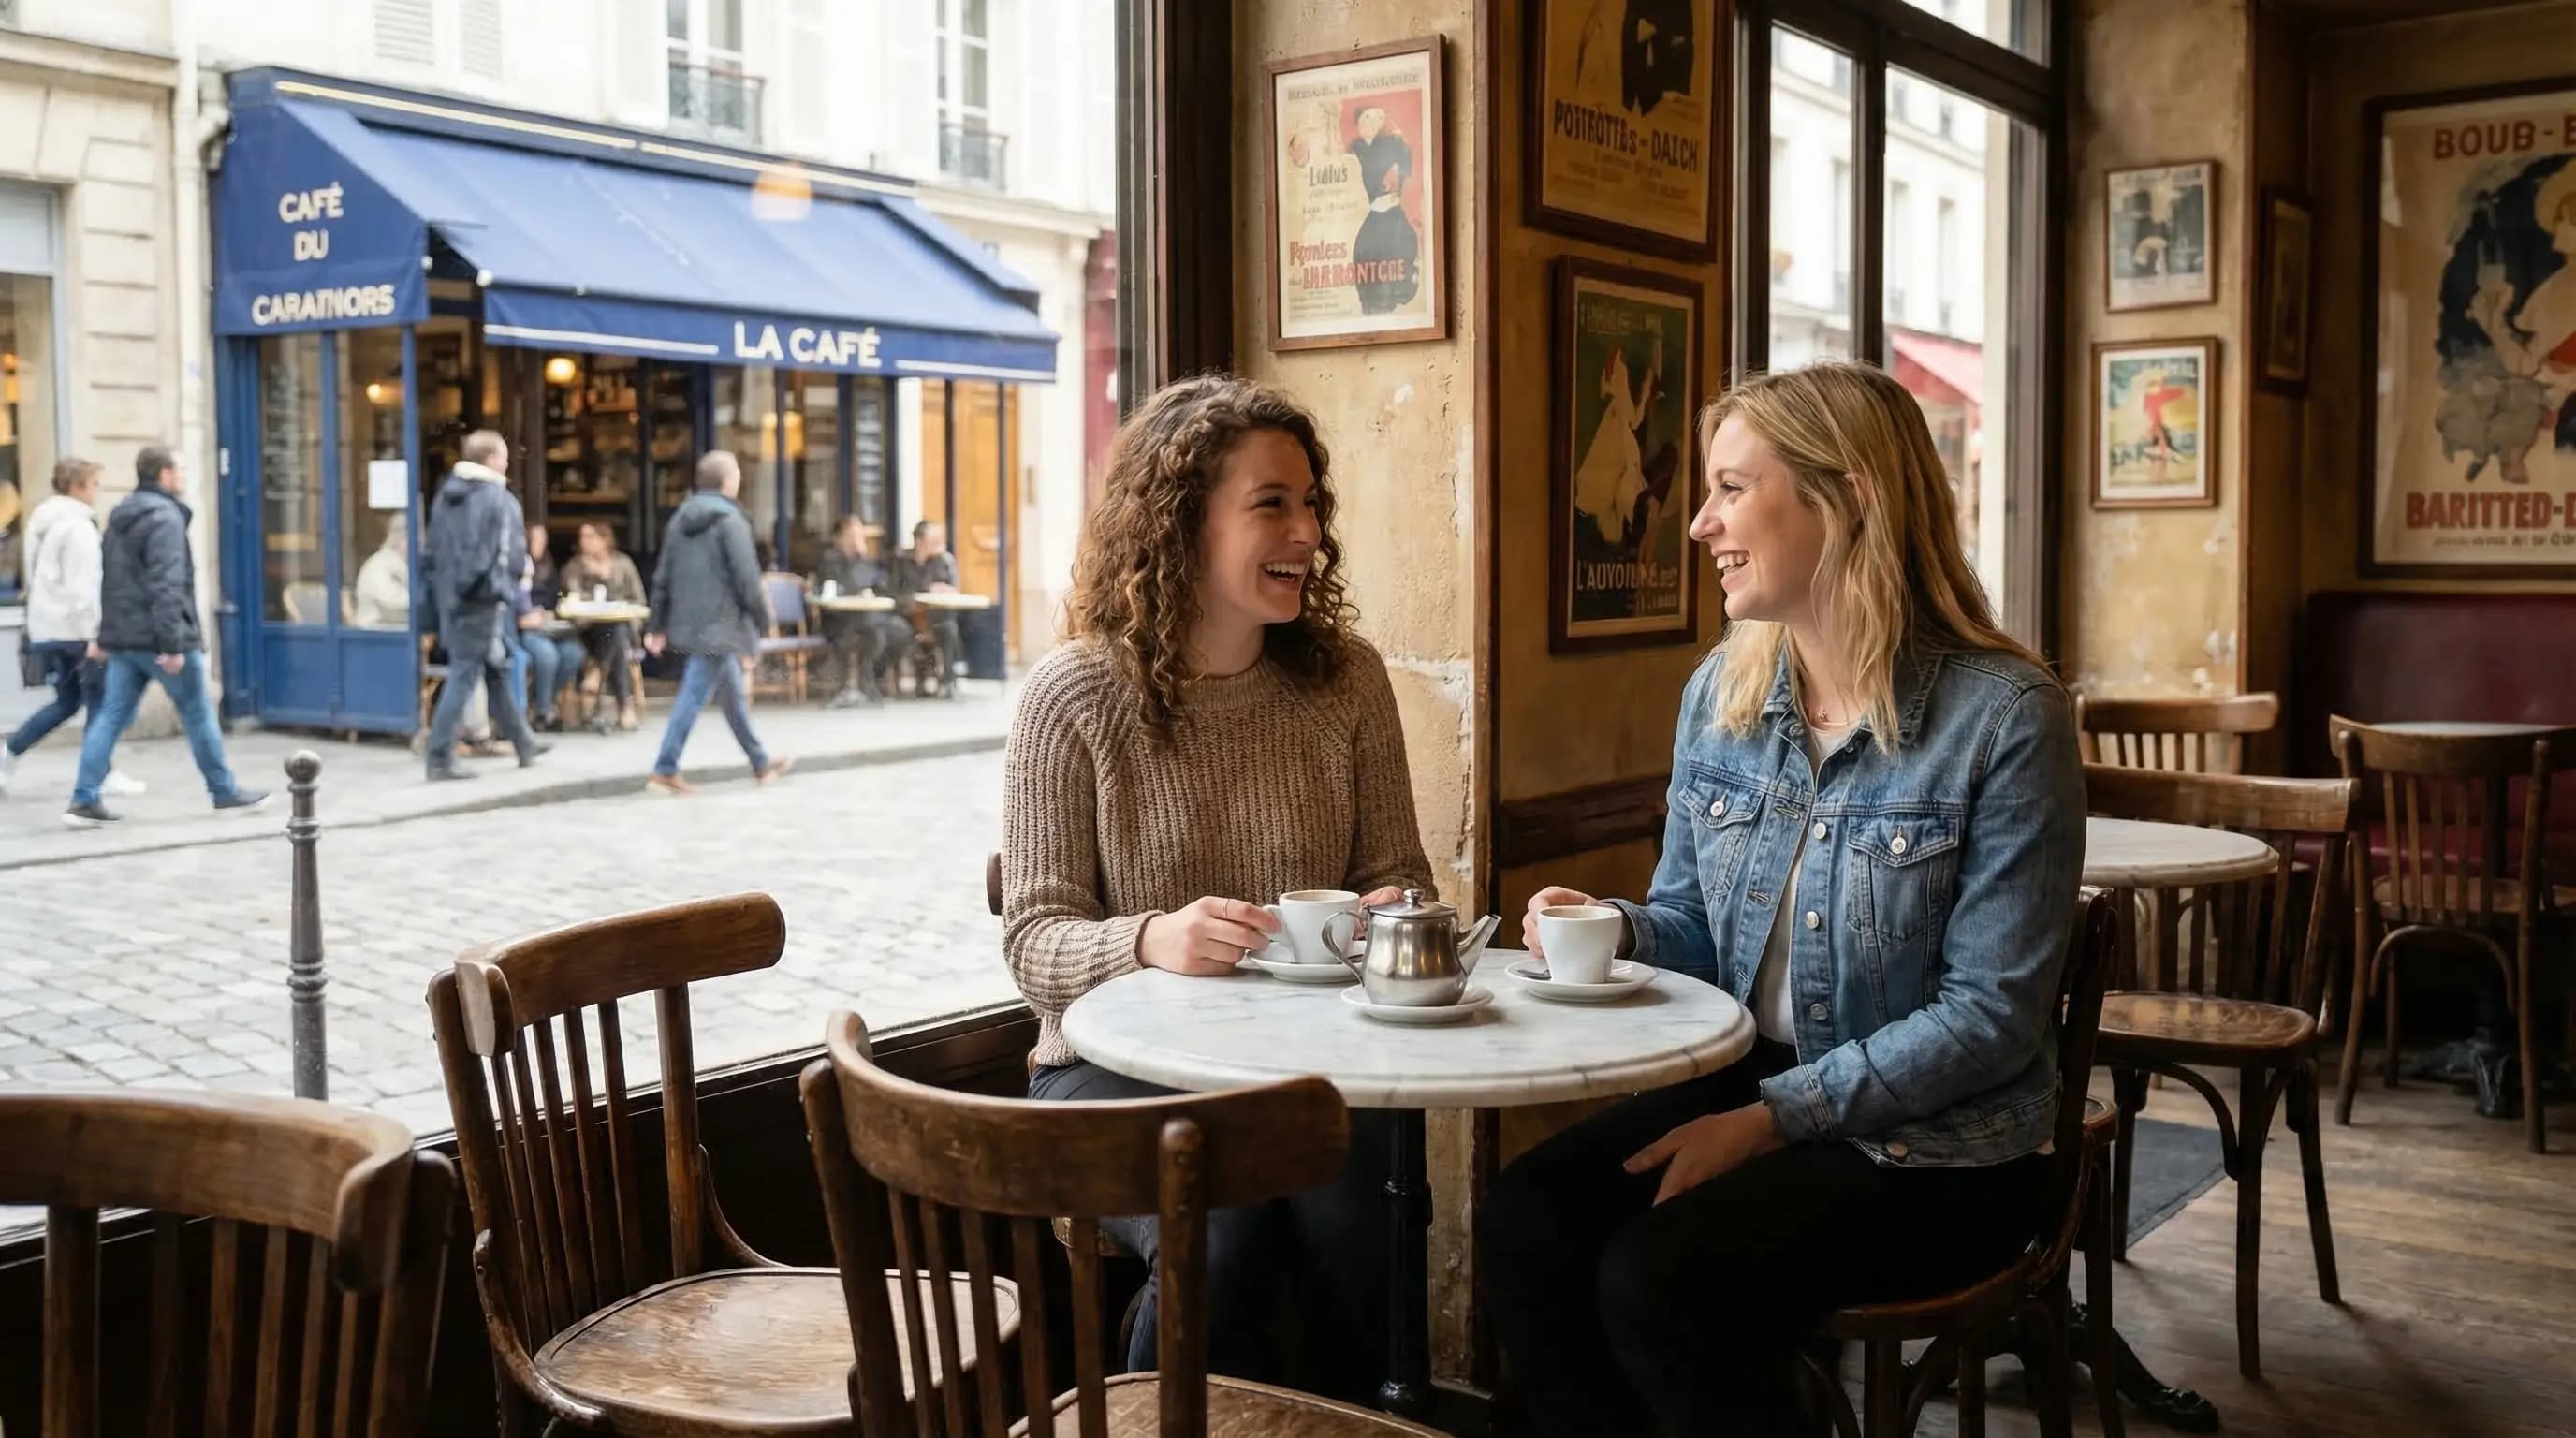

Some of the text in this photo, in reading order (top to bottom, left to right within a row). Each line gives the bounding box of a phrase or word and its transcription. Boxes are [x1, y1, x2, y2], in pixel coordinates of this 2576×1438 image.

[279, 180, 344, 223] CAFÉ
[294, 228, 329, 261] DU
[734, 321, 882, 368] LA CAFÉ
